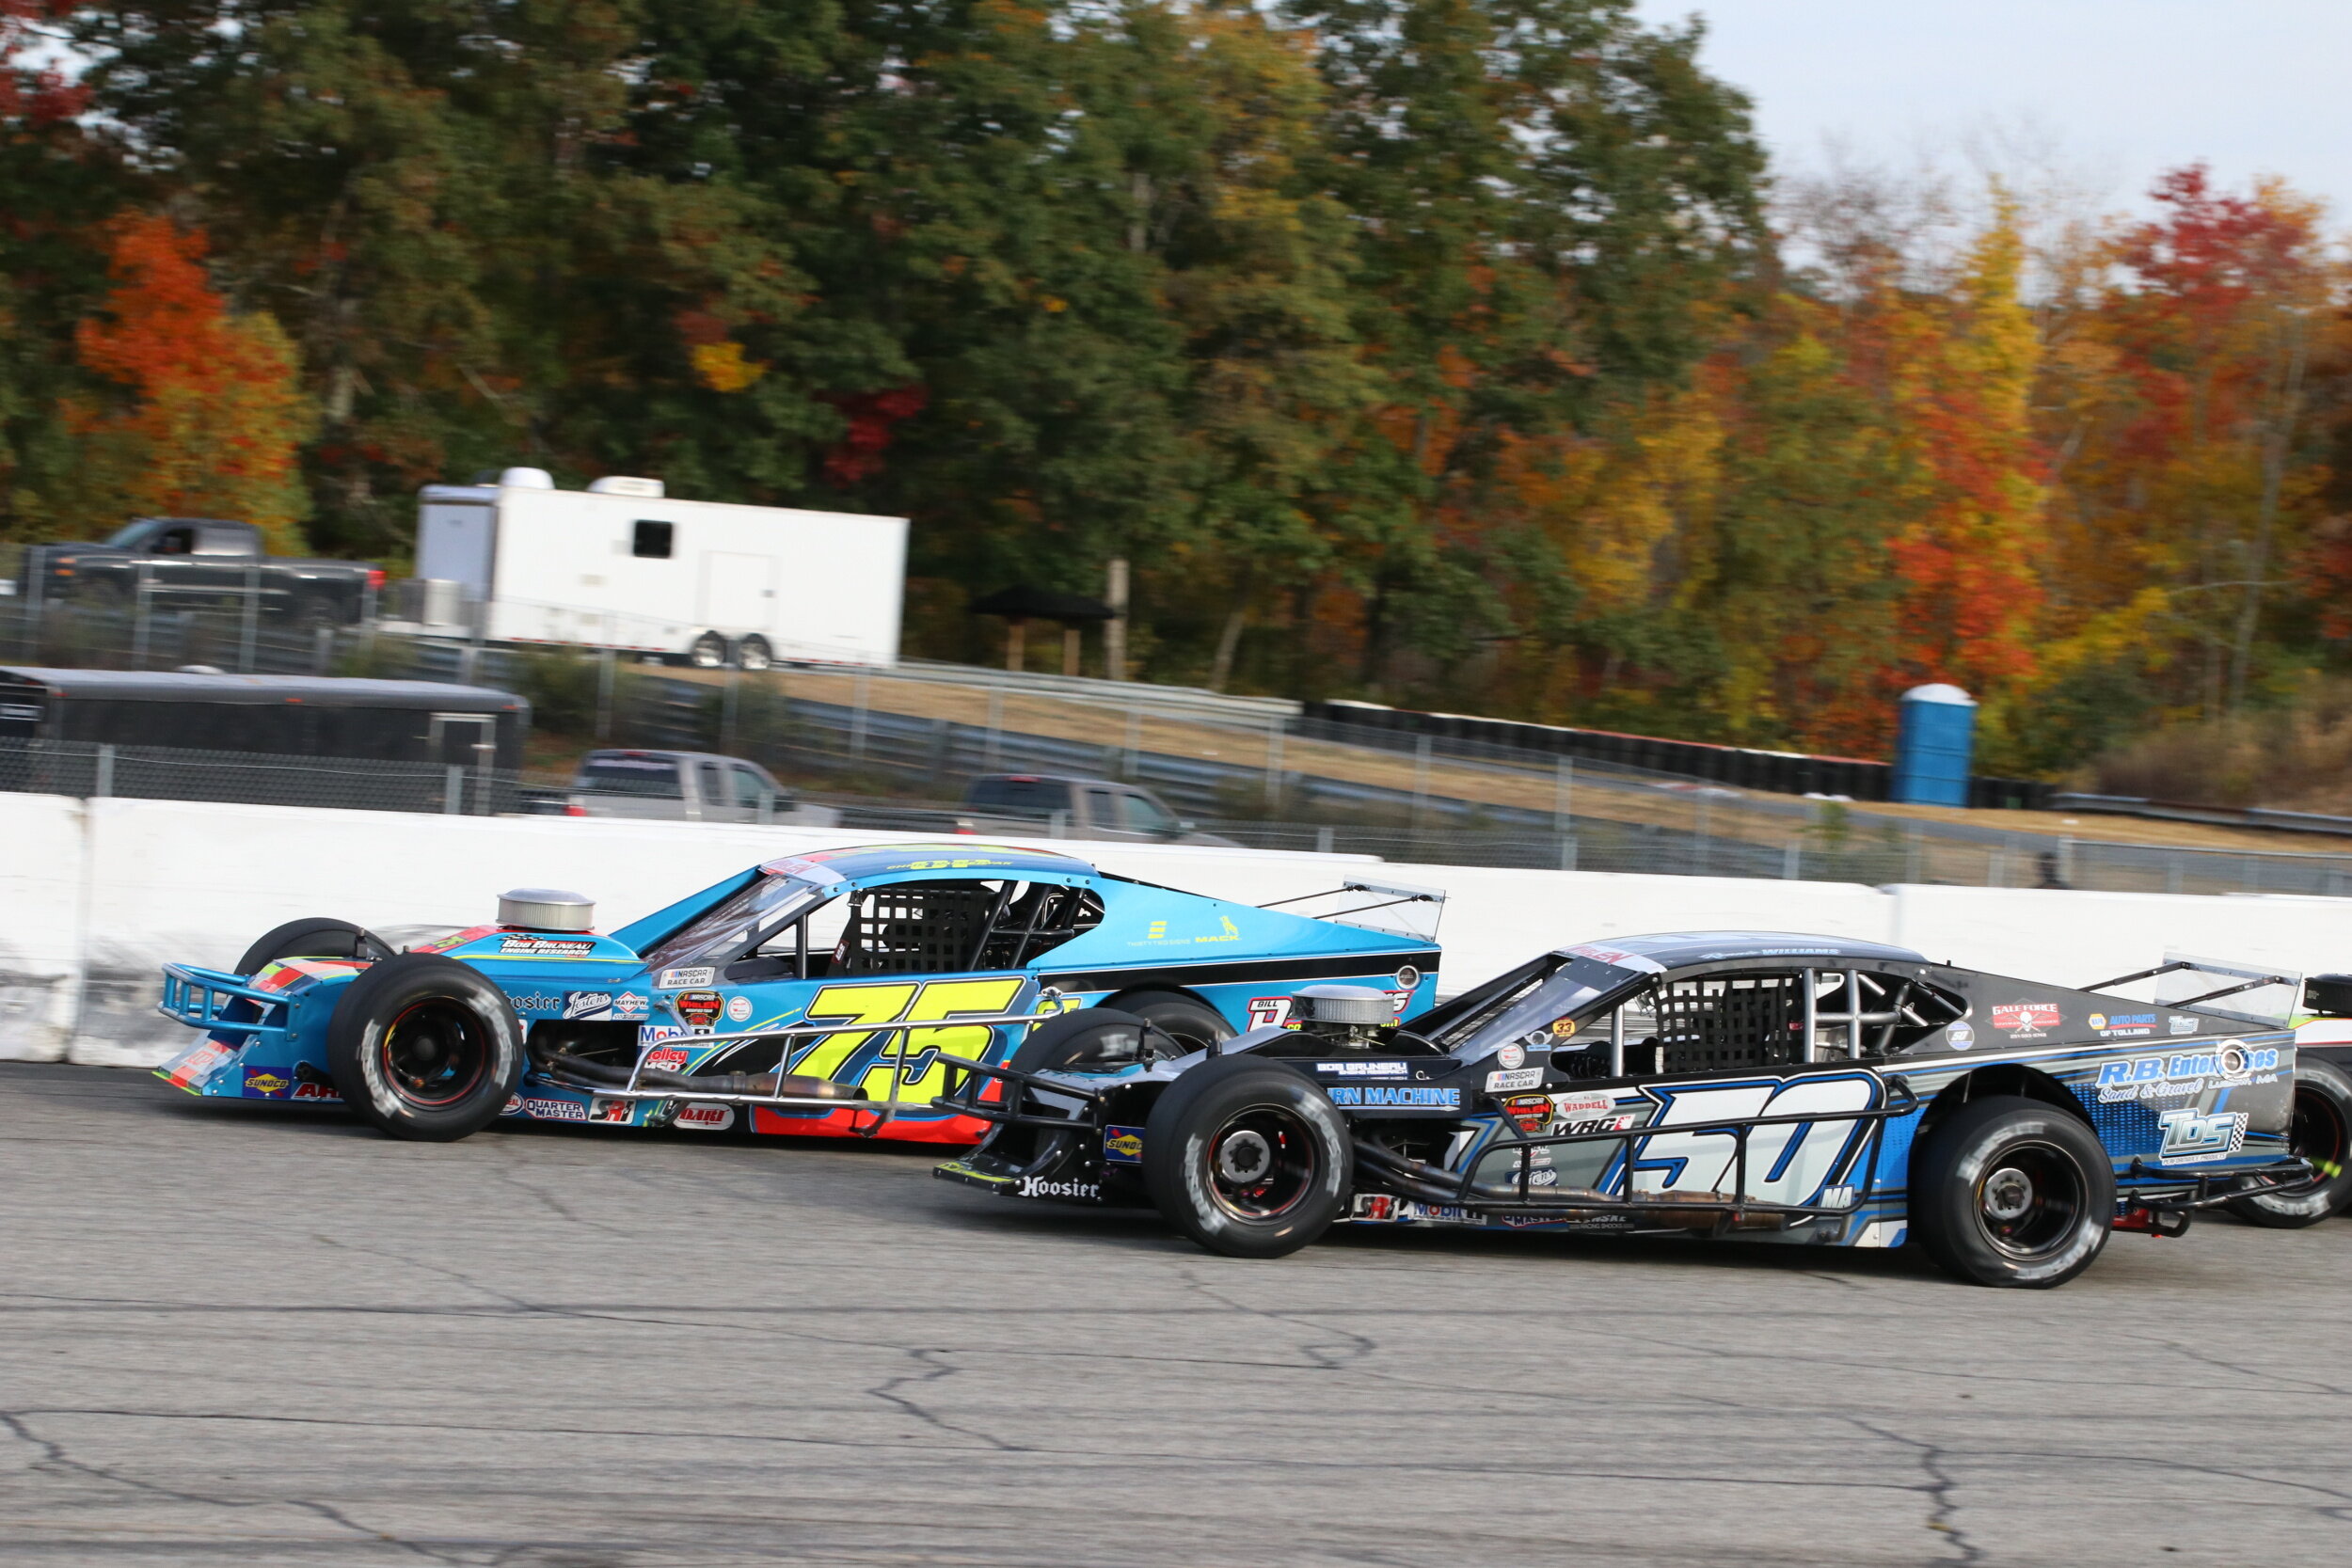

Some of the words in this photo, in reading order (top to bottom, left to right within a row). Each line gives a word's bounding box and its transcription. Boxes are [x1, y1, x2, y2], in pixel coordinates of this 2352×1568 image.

[501, 940, 532, 948] BOB
[532, 940, 593, 950] BRUNEAU
[506, 990, 561, 1010] osier
[563, 991, 612, 1019] Jostens
[678, 1001, 720, 1009] WHELEN
[1992, 1006, 2022, 1016] GALE
[2023, 1004, 2058, 1012] FORCE
[2109, 1015, 2130, 1025] AUTO
[2131, 1014, 2156, 1024] PARTS
[1556, 1022, 1572, 1033] 33
[2113, 1028, 2151, 1037] TOLLAND
[641, 1027, 687, 1041] Mob
[1950, 1031, 1968, 1040] 50
[787, 978, 1025, 1103] 75
[647, 1048, 690, 1065] olley
[644, 1061, 680, 1072] MSD
[1316, 1063, 1344, 1071] BOB
[1346, 1062, 1408, 1070] BRUNEAU
[2098, 1059, 2166, 1085] R.B.
[1505, 1070, 1535, 1080] NASCAR
[2256, 1074, 2278, 1084] MA
[246, 1078, 288, 1088] SUNOCO
[1494, 1081, 1517, 1089] RACE
[1365, 1087, 1460, 1105] MACHINE
[2100, 1086, 2137, 1103] Sand
[2140, 1085, 2155, 1099] &
[2157, 1078, 2204, 1097] Gravel
[527, 1101, 580, 1111] QUARTER
[1507, 1103, 1549, 1115] WHELEN
[1564, 1100, 1608, 1112] WADDELL
[536, 1109, 583, 1118] MASTER
[679, 1108, 729, 1122] DART
[1626, 1077, 1872, 1208] 50
[1018, 1176, 1100, 1197] Hoosier
[1820, 1186, 1852, 1209] MA
